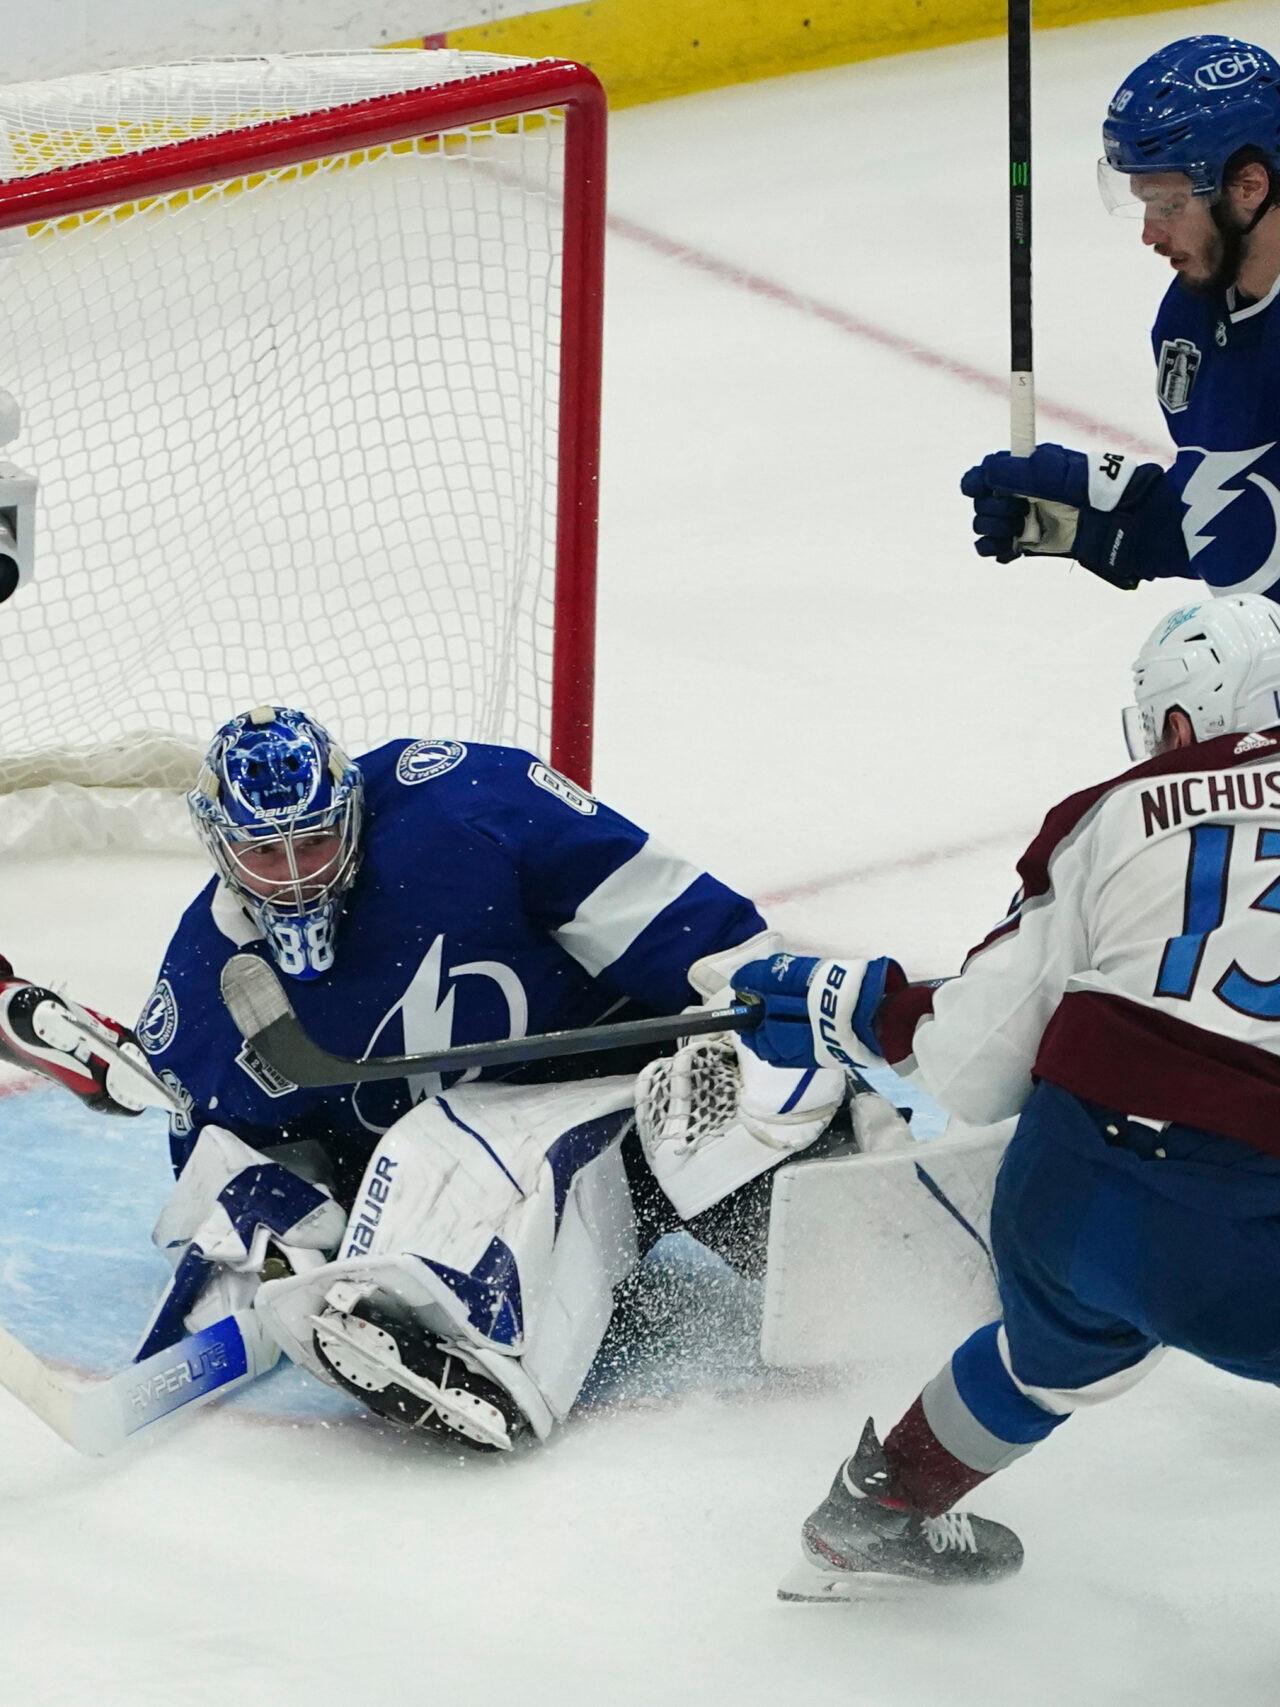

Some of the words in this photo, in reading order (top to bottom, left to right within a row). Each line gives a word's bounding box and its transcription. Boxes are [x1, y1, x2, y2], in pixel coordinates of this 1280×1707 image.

[1198, 52, 1260, 84] TGH
[1233, 737, 1278, 755] adidas
[254, 802, 308, 819] BAUER
[1153, 822, 1280, 1022] 13
[272, 918, 335, 976] 88
